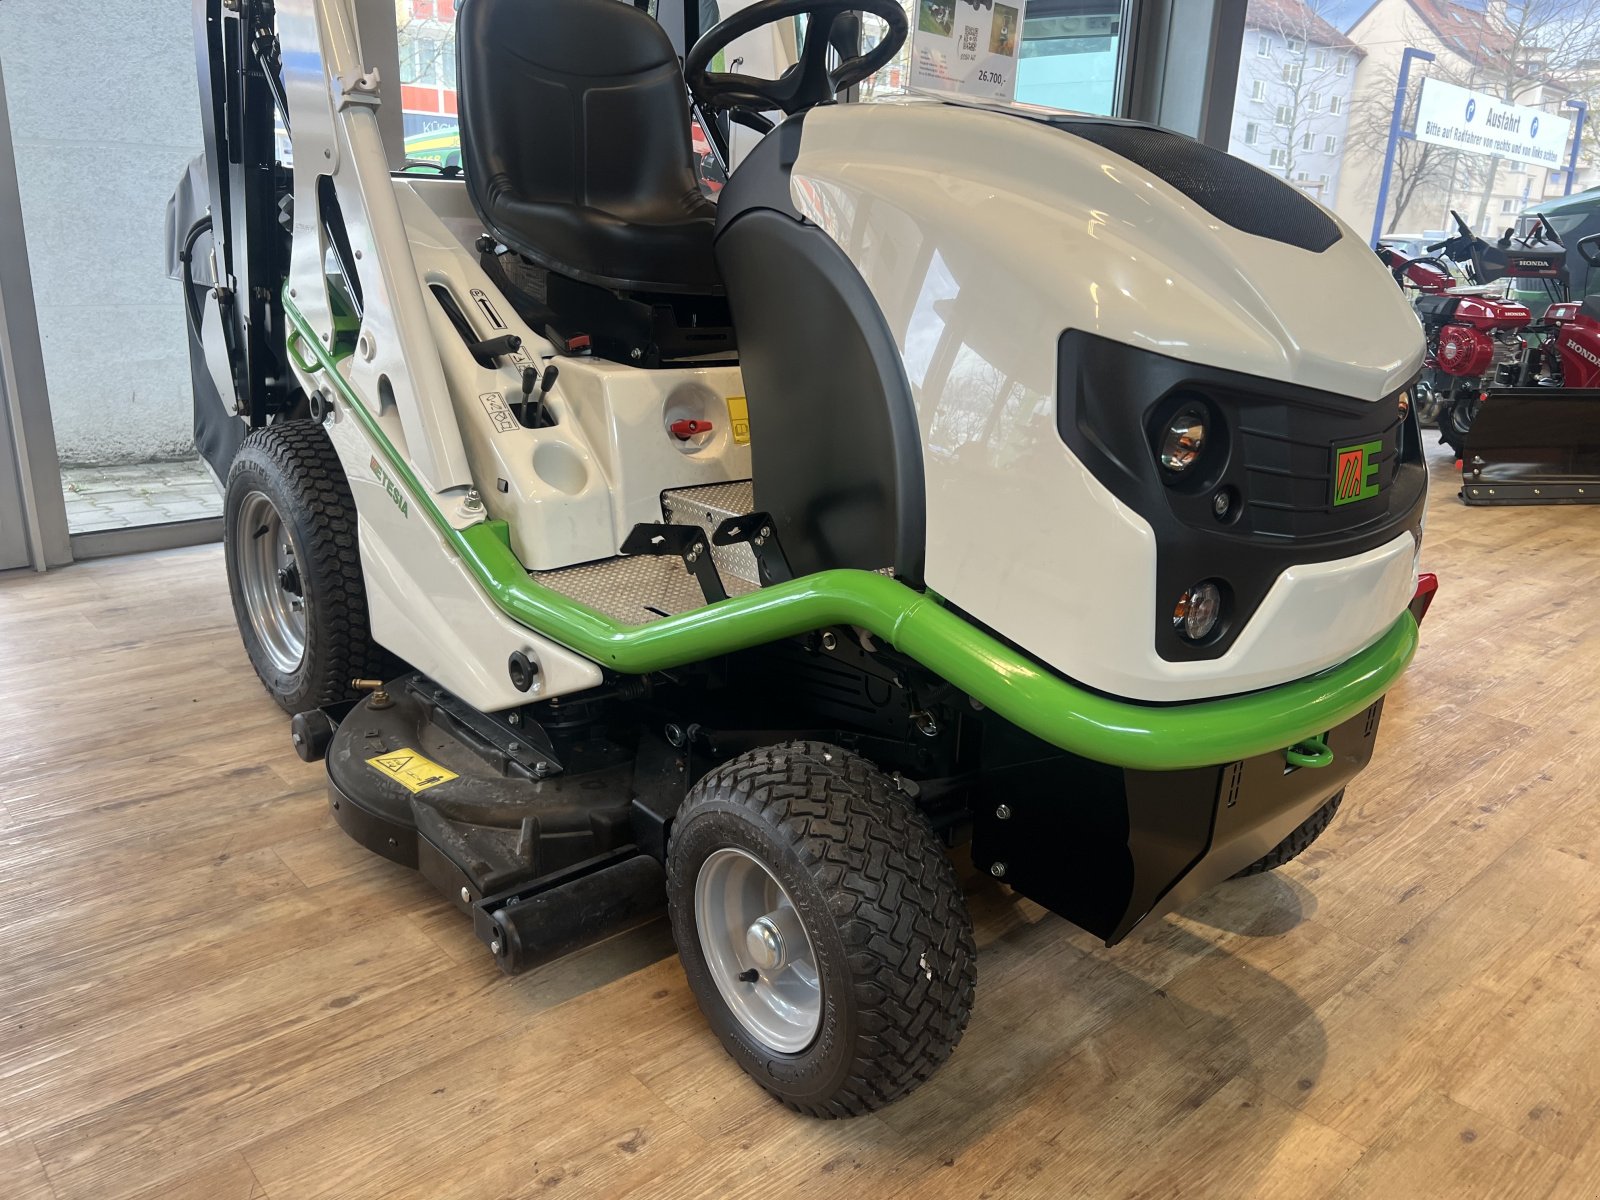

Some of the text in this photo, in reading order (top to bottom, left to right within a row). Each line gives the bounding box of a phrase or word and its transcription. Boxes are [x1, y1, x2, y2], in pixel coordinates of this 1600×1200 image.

[1486, 108, 1521, 133] Ausfahrt
[1426, 121, 1441, 136] Bitte
[1442, 126, 1454, 139] auf
[1453, 128, 1483, 145] Radfahrer
[1483, 137, 1493, 148] von
[1494, 139, 1511, 152] rechts
[1511, 142, 1522, 154] und
[1531, 146, 1543, 159] links
[373, 464, 408, 519] ETESIA
